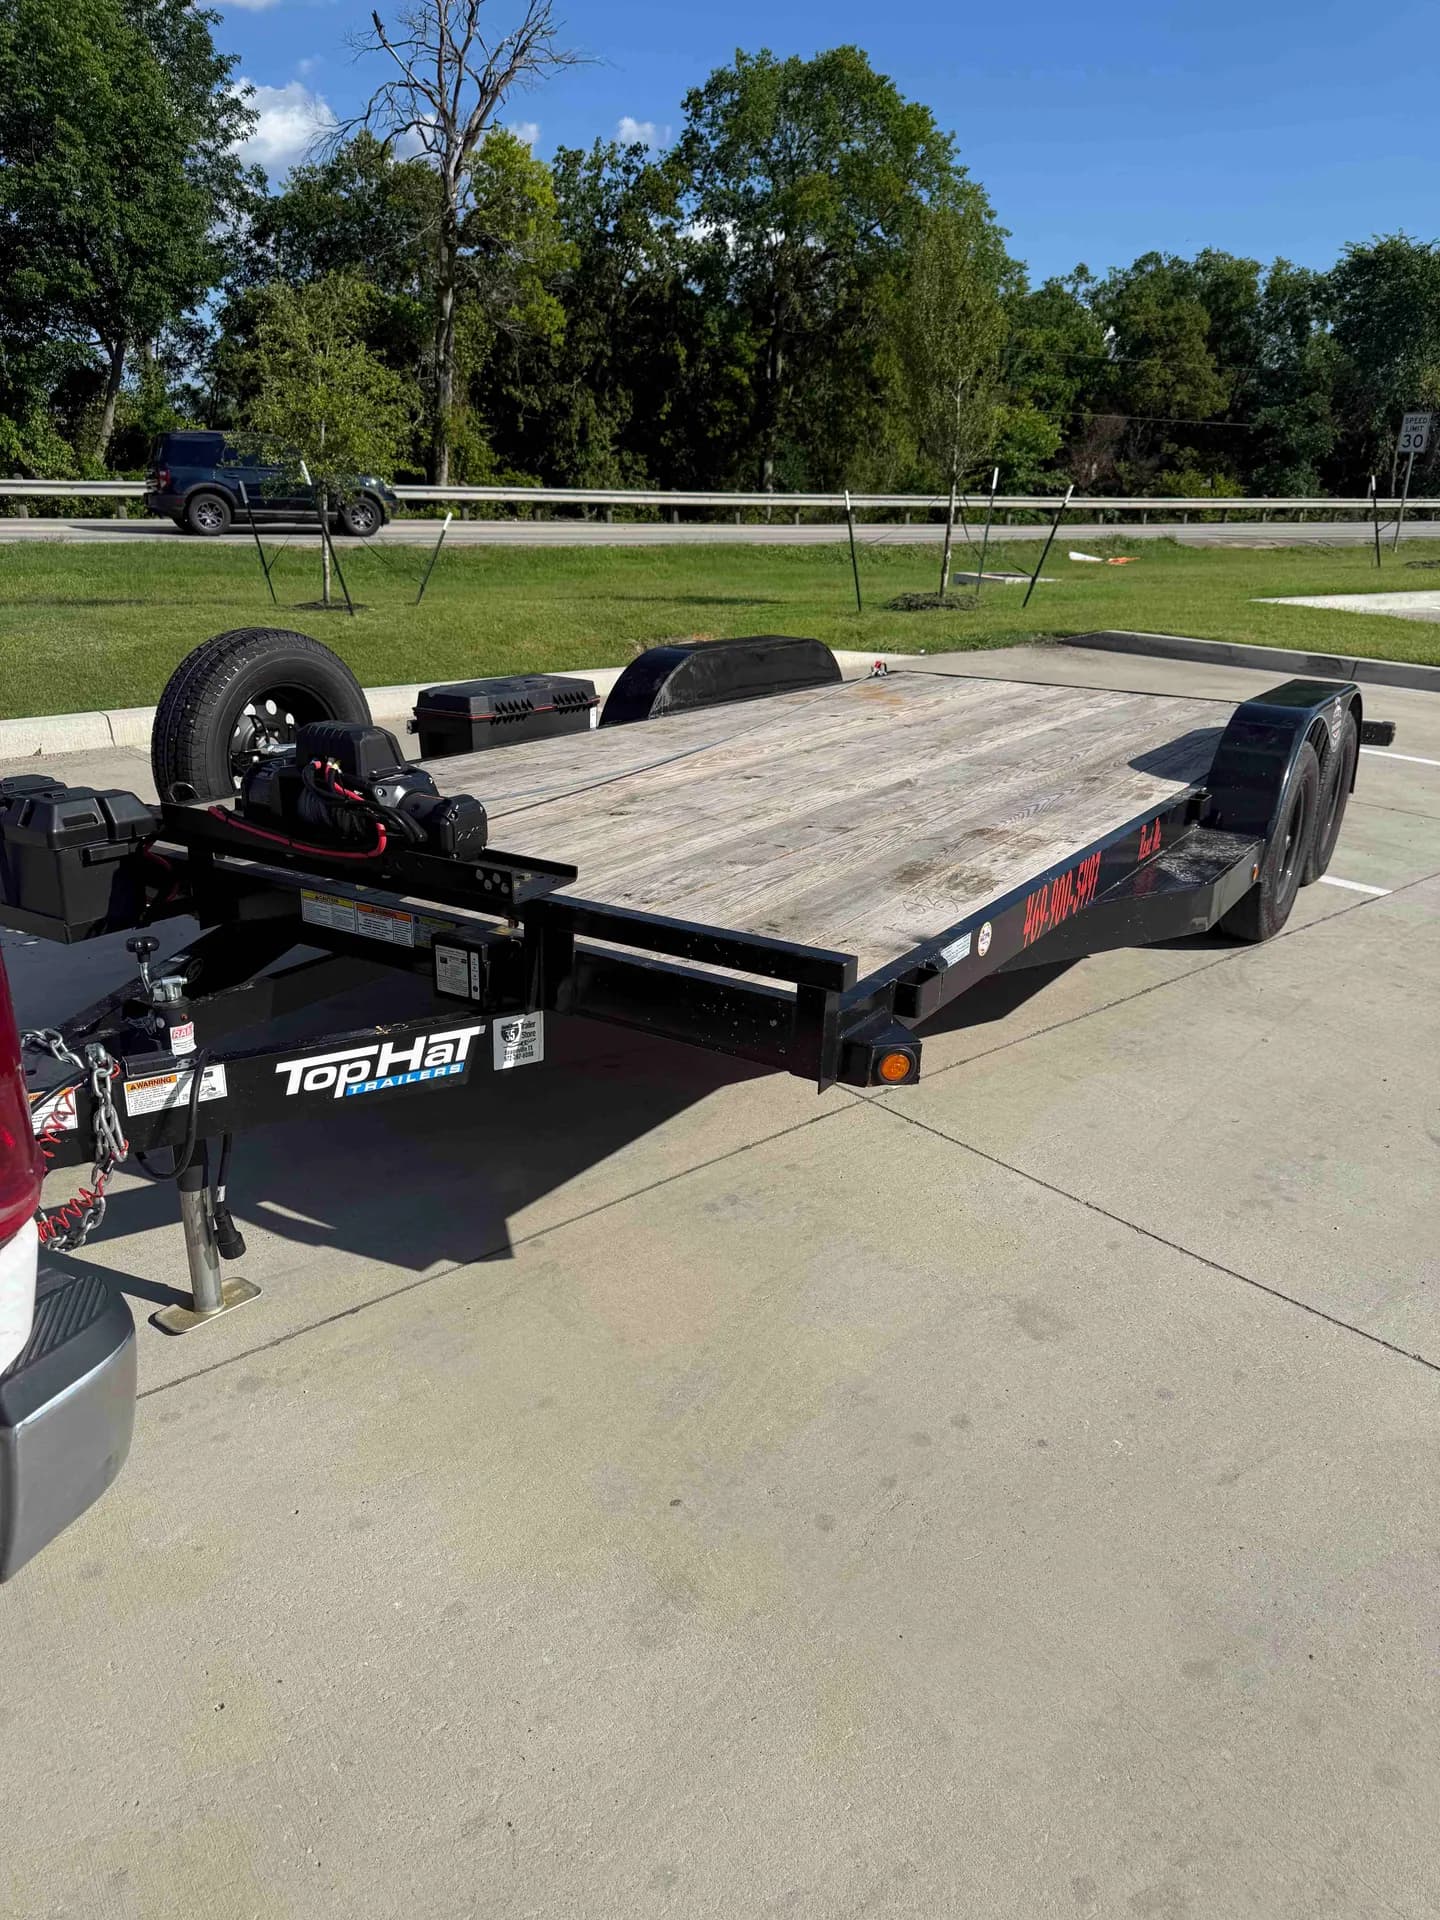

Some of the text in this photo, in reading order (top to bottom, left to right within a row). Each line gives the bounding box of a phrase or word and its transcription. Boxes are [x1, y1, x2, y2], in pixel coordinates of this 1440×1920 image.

[1405, 416, 1427, 424] SPEED
[1402, 434, 1423, 448] 30
[505, 1028, 515, 1041] 35
[521, 1031, 536, 1039] Store
[137, 1075, 172, 1089] WARNING
[350, 1063, 461, 1095] TRAILERS
